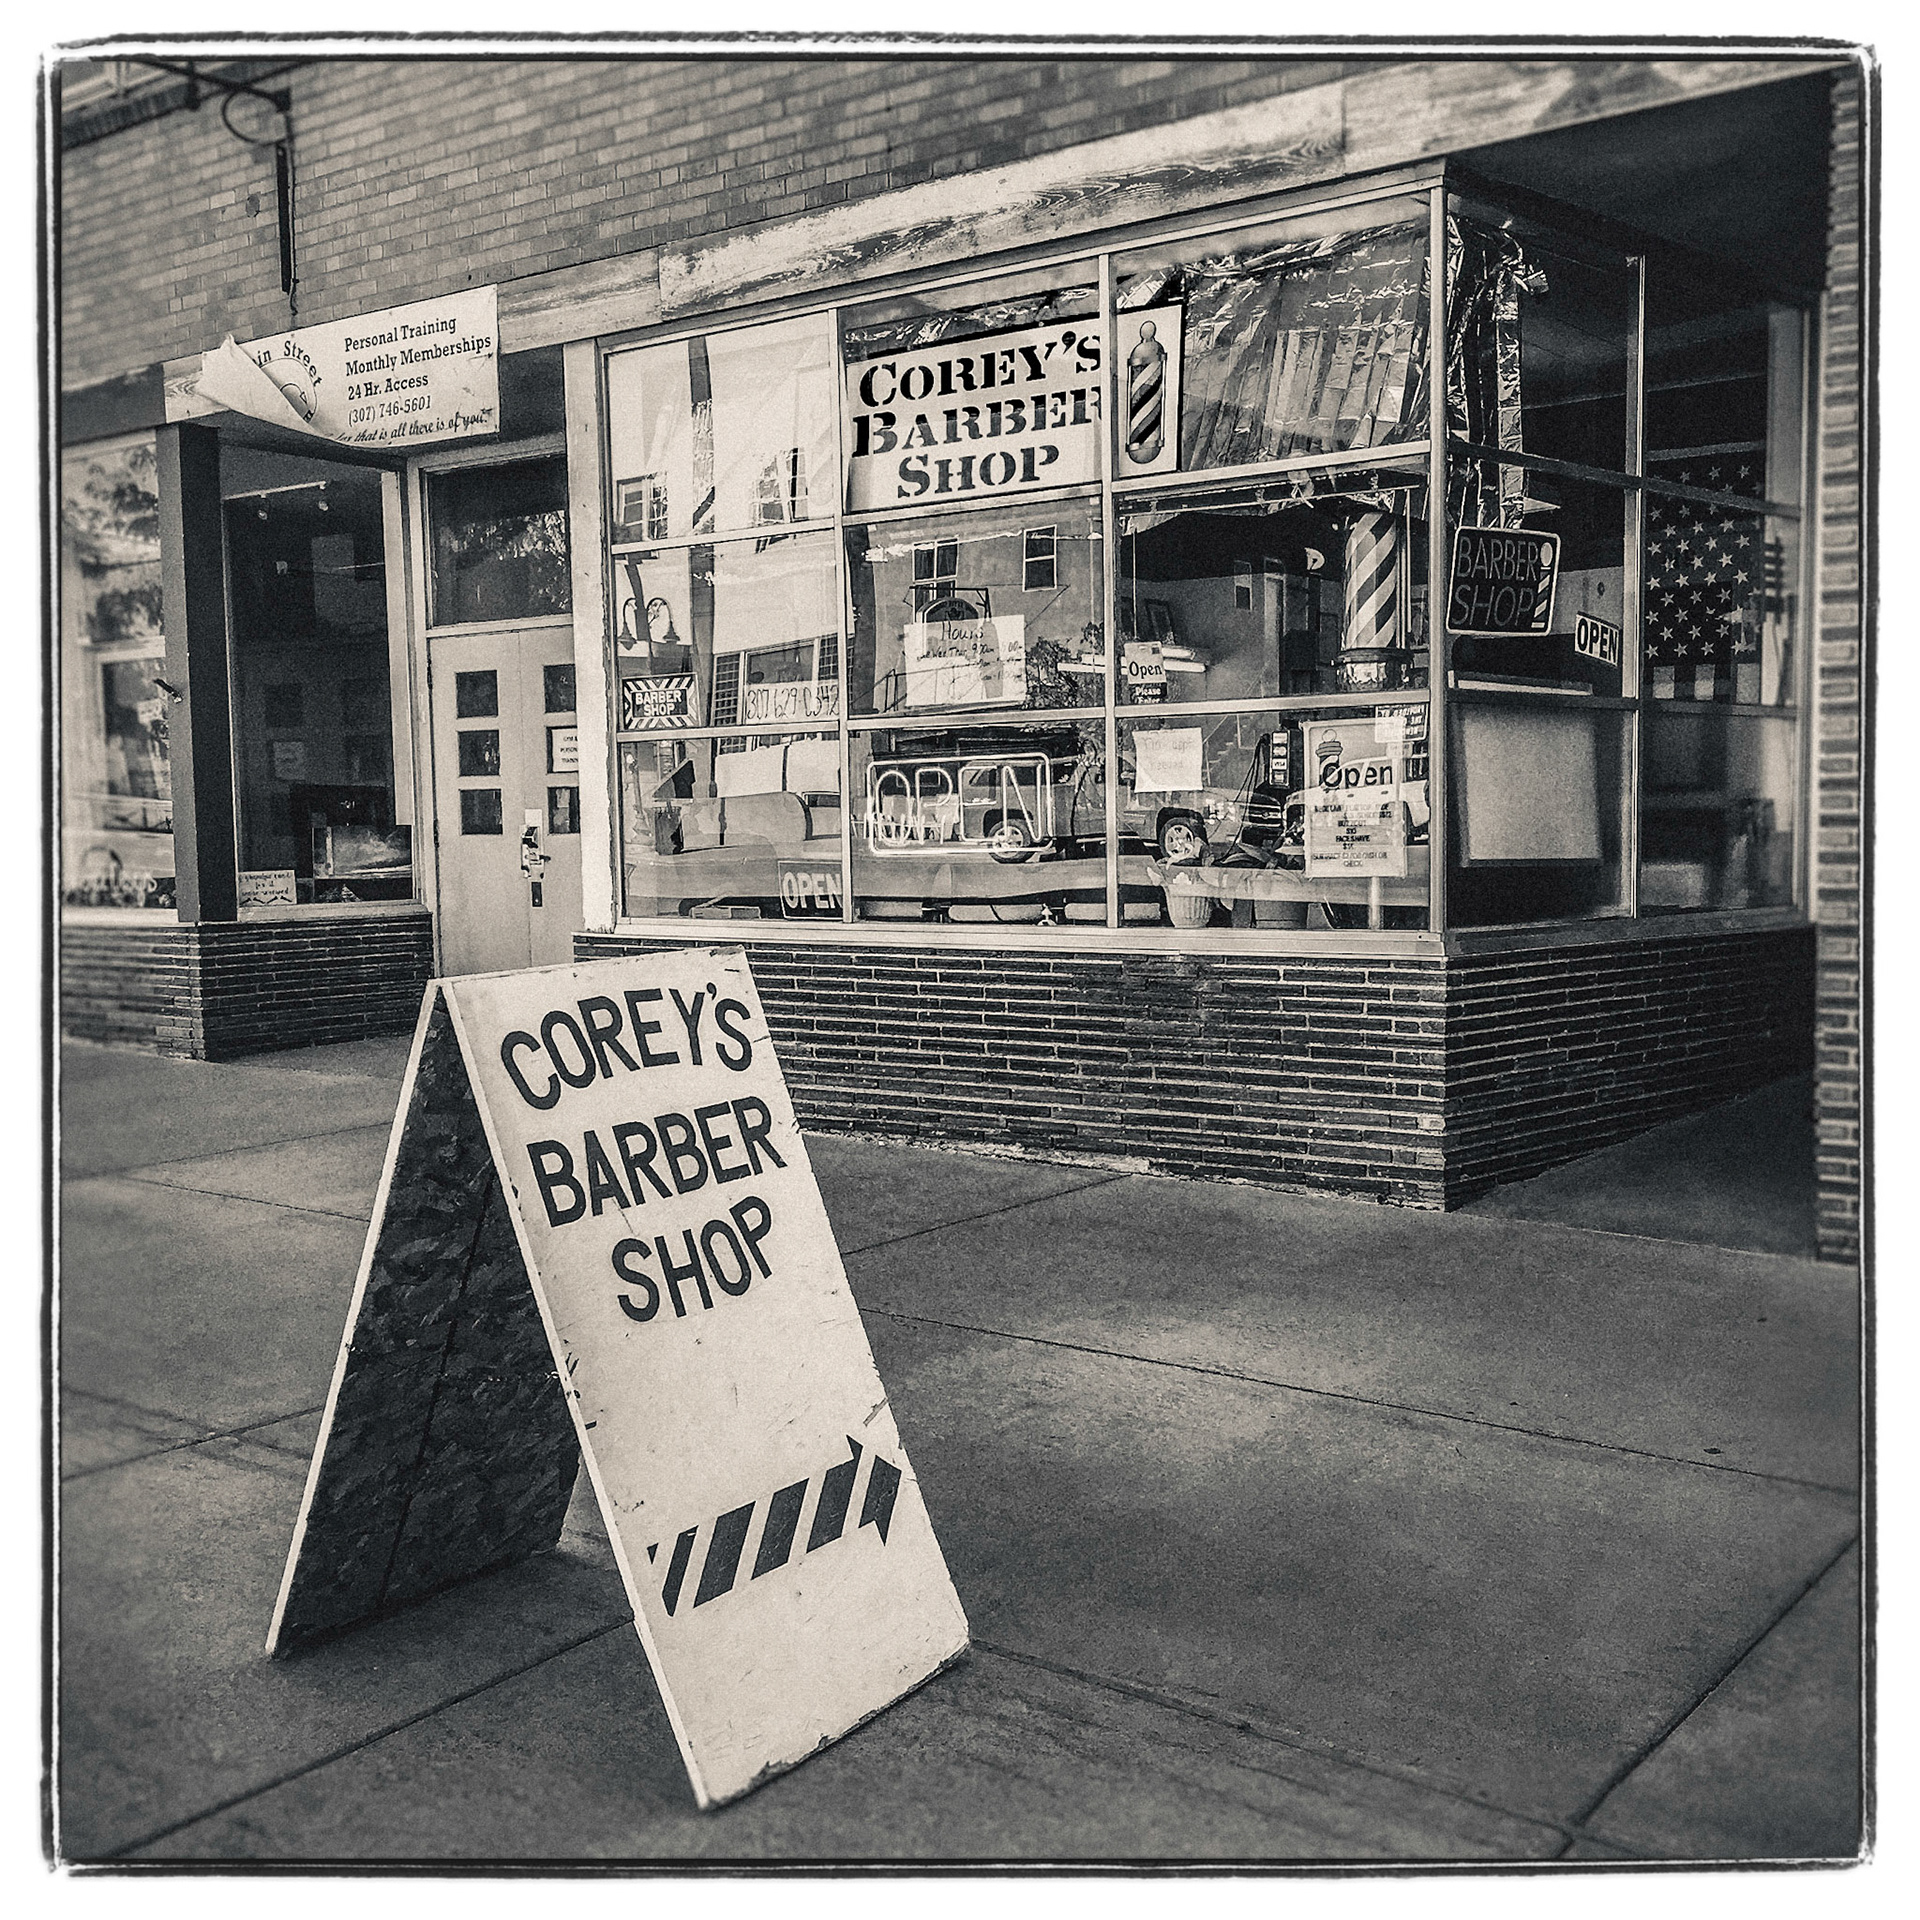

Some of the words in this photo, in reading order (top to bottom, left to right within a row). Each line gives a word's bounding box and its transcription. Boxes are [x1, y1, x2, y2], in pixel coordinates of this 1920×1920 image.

[344, 326, 399, 353] Personal
[400, 318, 457, 340] Training
[283, 340, 323, 387] Street
[345, 354, 397, 377] Monthly
[400, 335, 491, 366] Memberships
[859, 330, 1101, 408] COREY'S
[347, 384, 362, 401] 24
[363, 381, 382, 397] Hr.
[384, 374, 429, 394] Access
[347, 405, 376, 428] (307)
[379, 395, 431, 418] 746-5601
[379, 427, 388, 440] is
[391, 421, 406, 438] all
[409, 418, 434, 435] there
[436, 417, 445, 430] is
[449, 410, 461, 432] of
[852, 385, 1101, 458] BARBER
[897, 444, 1061, 498] SHOP
[1456, 537, 1538, 582] BARBER
[1451, 584, 1534, 627] SHOP
[942, 621, 984, 640] Hours
[1577, 618, 1619, 666] OPEN
[1129, 661, 1163, 679] Open
[635, 689, 682, 703] BARBER
[643, 703, 676, 717] SHOP
[1135, 687, 1161, 696] Please
[1323, 763, 1393, 788] Open
[783, 872, 843, 909] OPEN
[500, 982, 752, 1110] COREY'S
[526, 1096, 788, 1227] BARBER
[611, 1196, 773, 1322] SHOP
